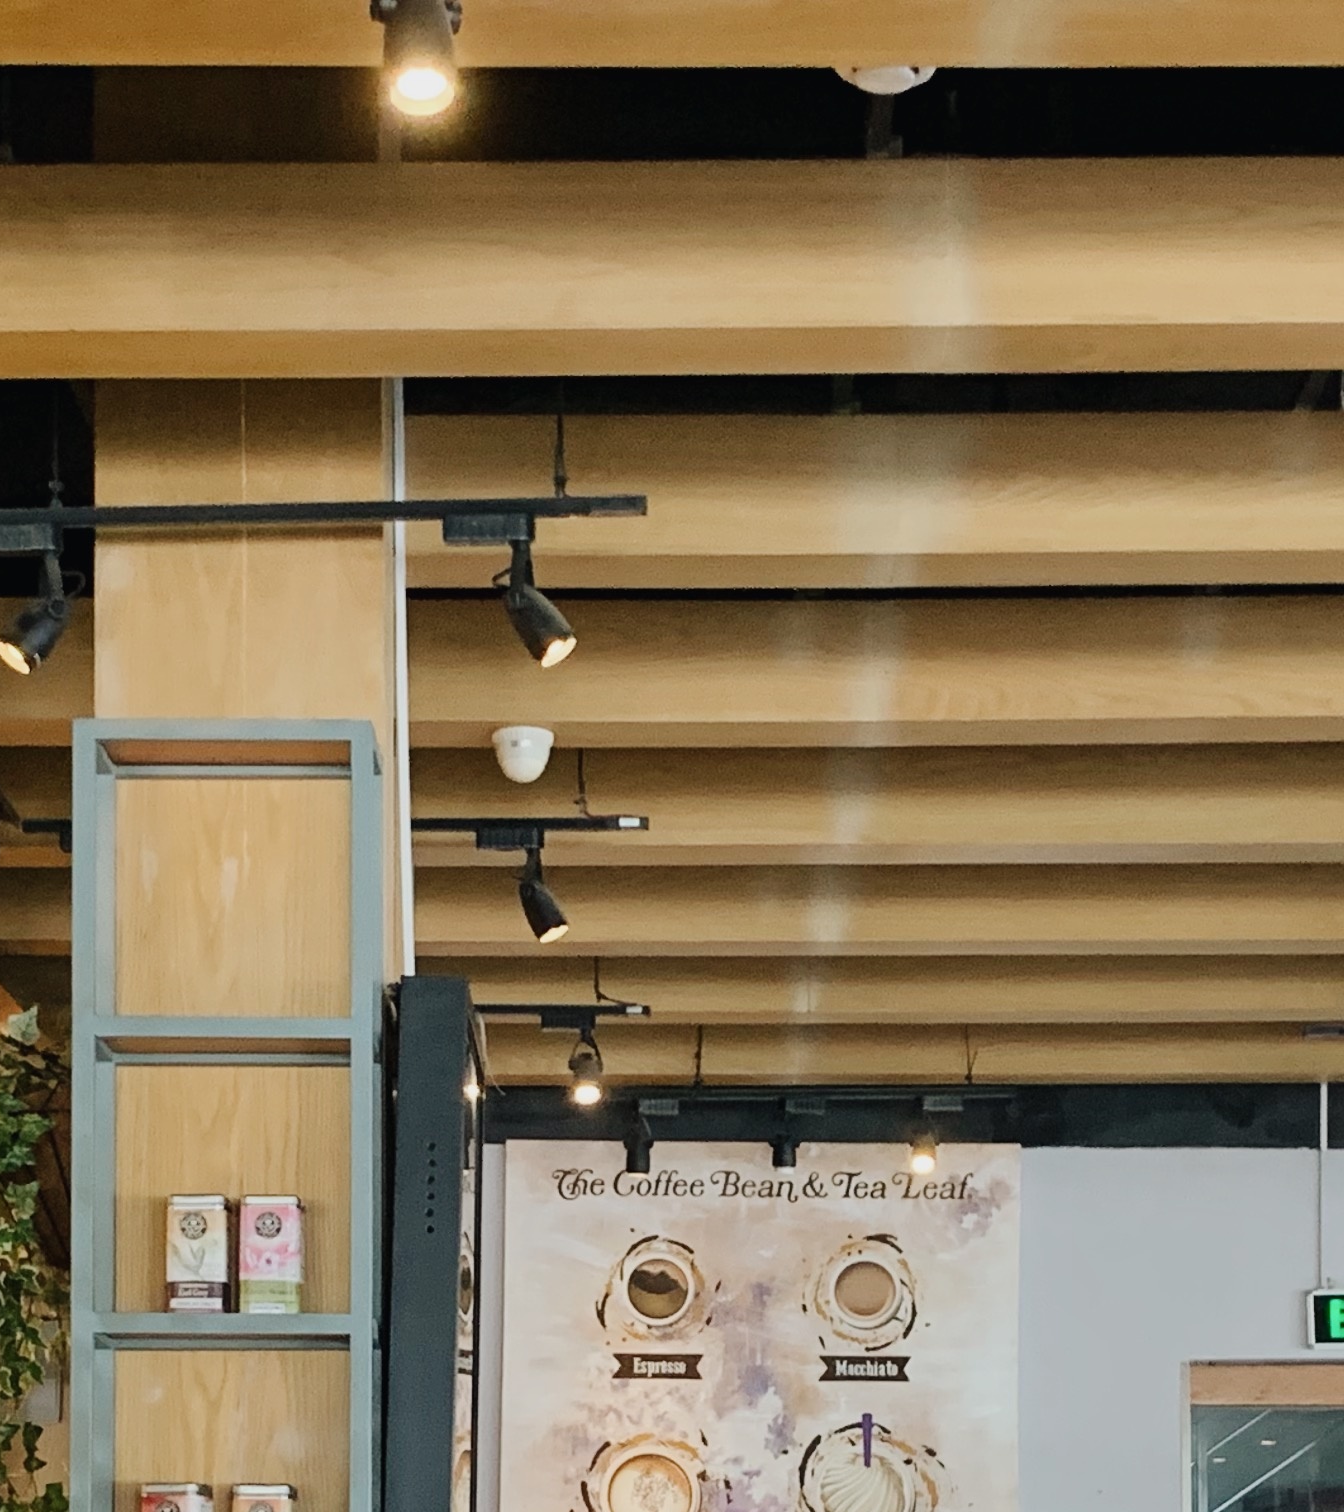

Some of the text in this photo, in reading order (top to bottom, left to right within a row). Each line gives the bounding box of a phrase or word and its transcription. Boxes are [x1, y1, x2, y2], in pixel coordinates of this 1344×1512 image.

[552, 1168, 974, 1203] The Coffee Bean & Tea Leaf
[633, 1356, 687, 1378] Espresso
[835, 1359, 899, 1376] Macchiato
